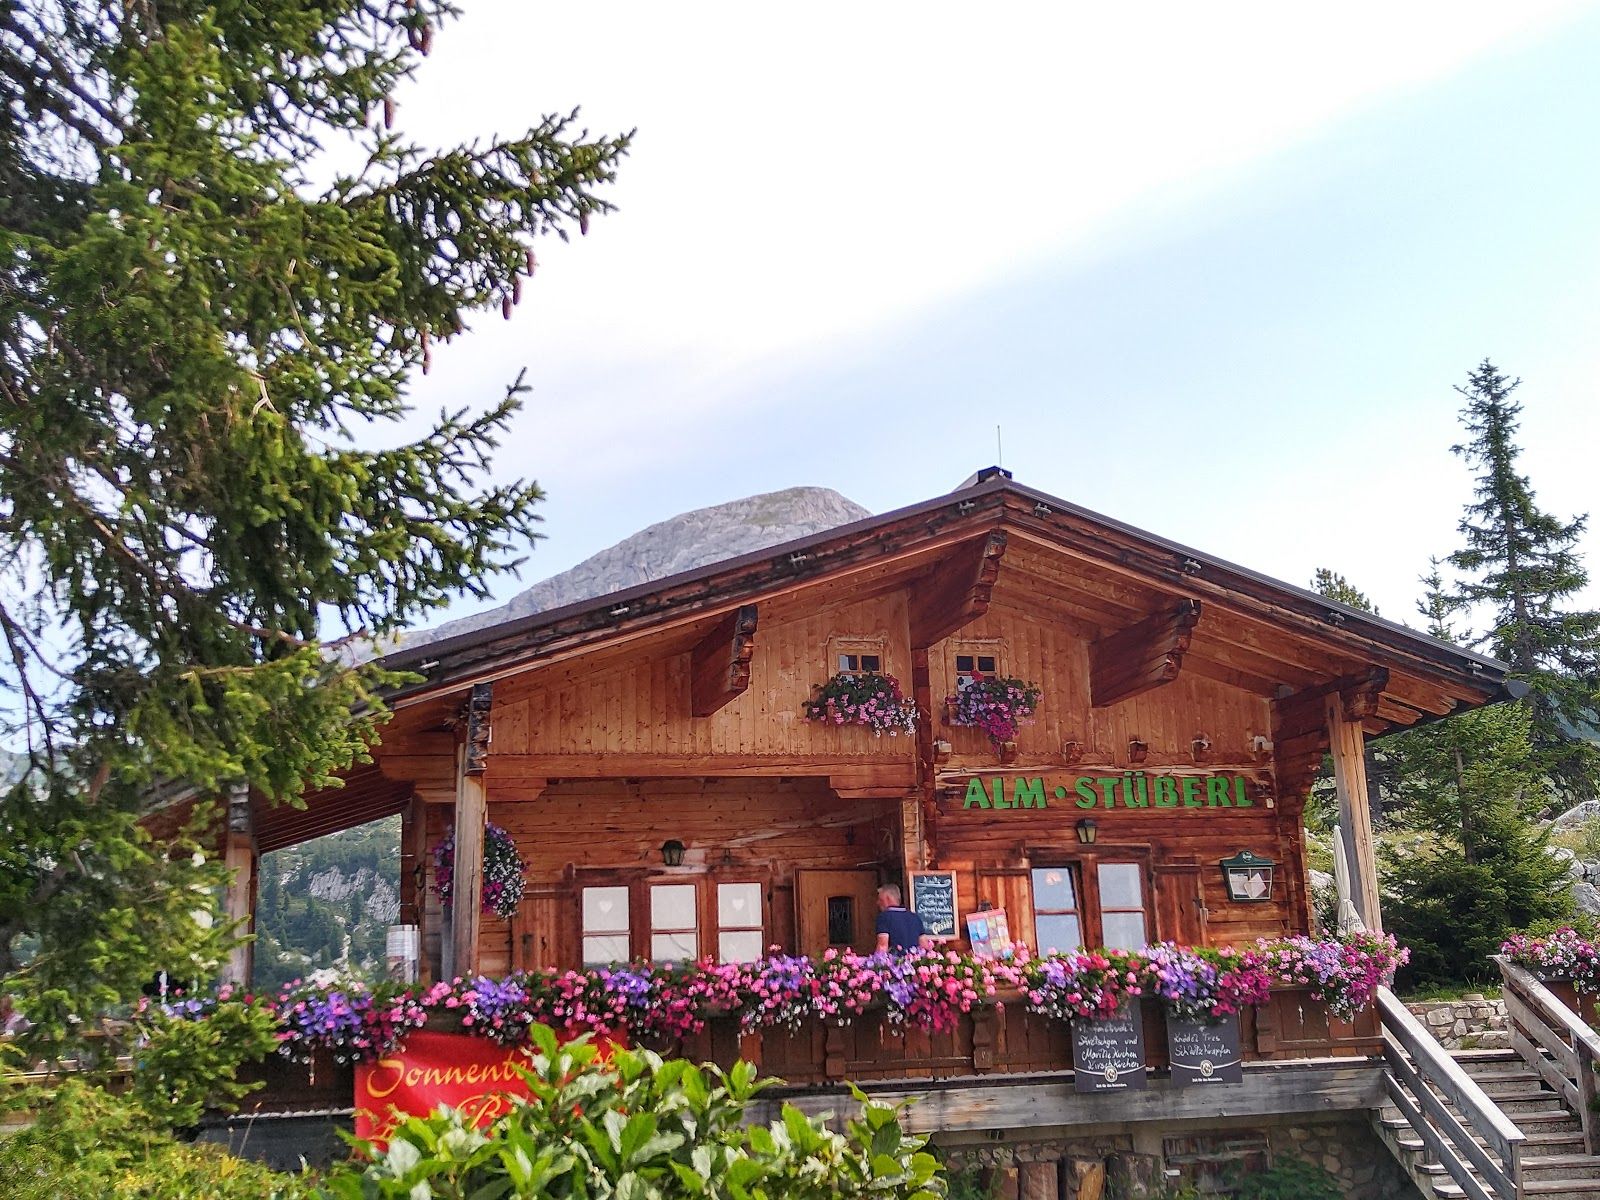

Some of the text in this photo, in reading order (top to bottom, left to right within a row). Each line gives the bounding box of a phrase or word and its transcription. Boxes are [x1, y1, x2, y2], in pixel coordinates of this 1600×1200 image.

[963, 771, 1253, 809] ALM STÜBERL
[1124, 1035, 1138, 1045] und
